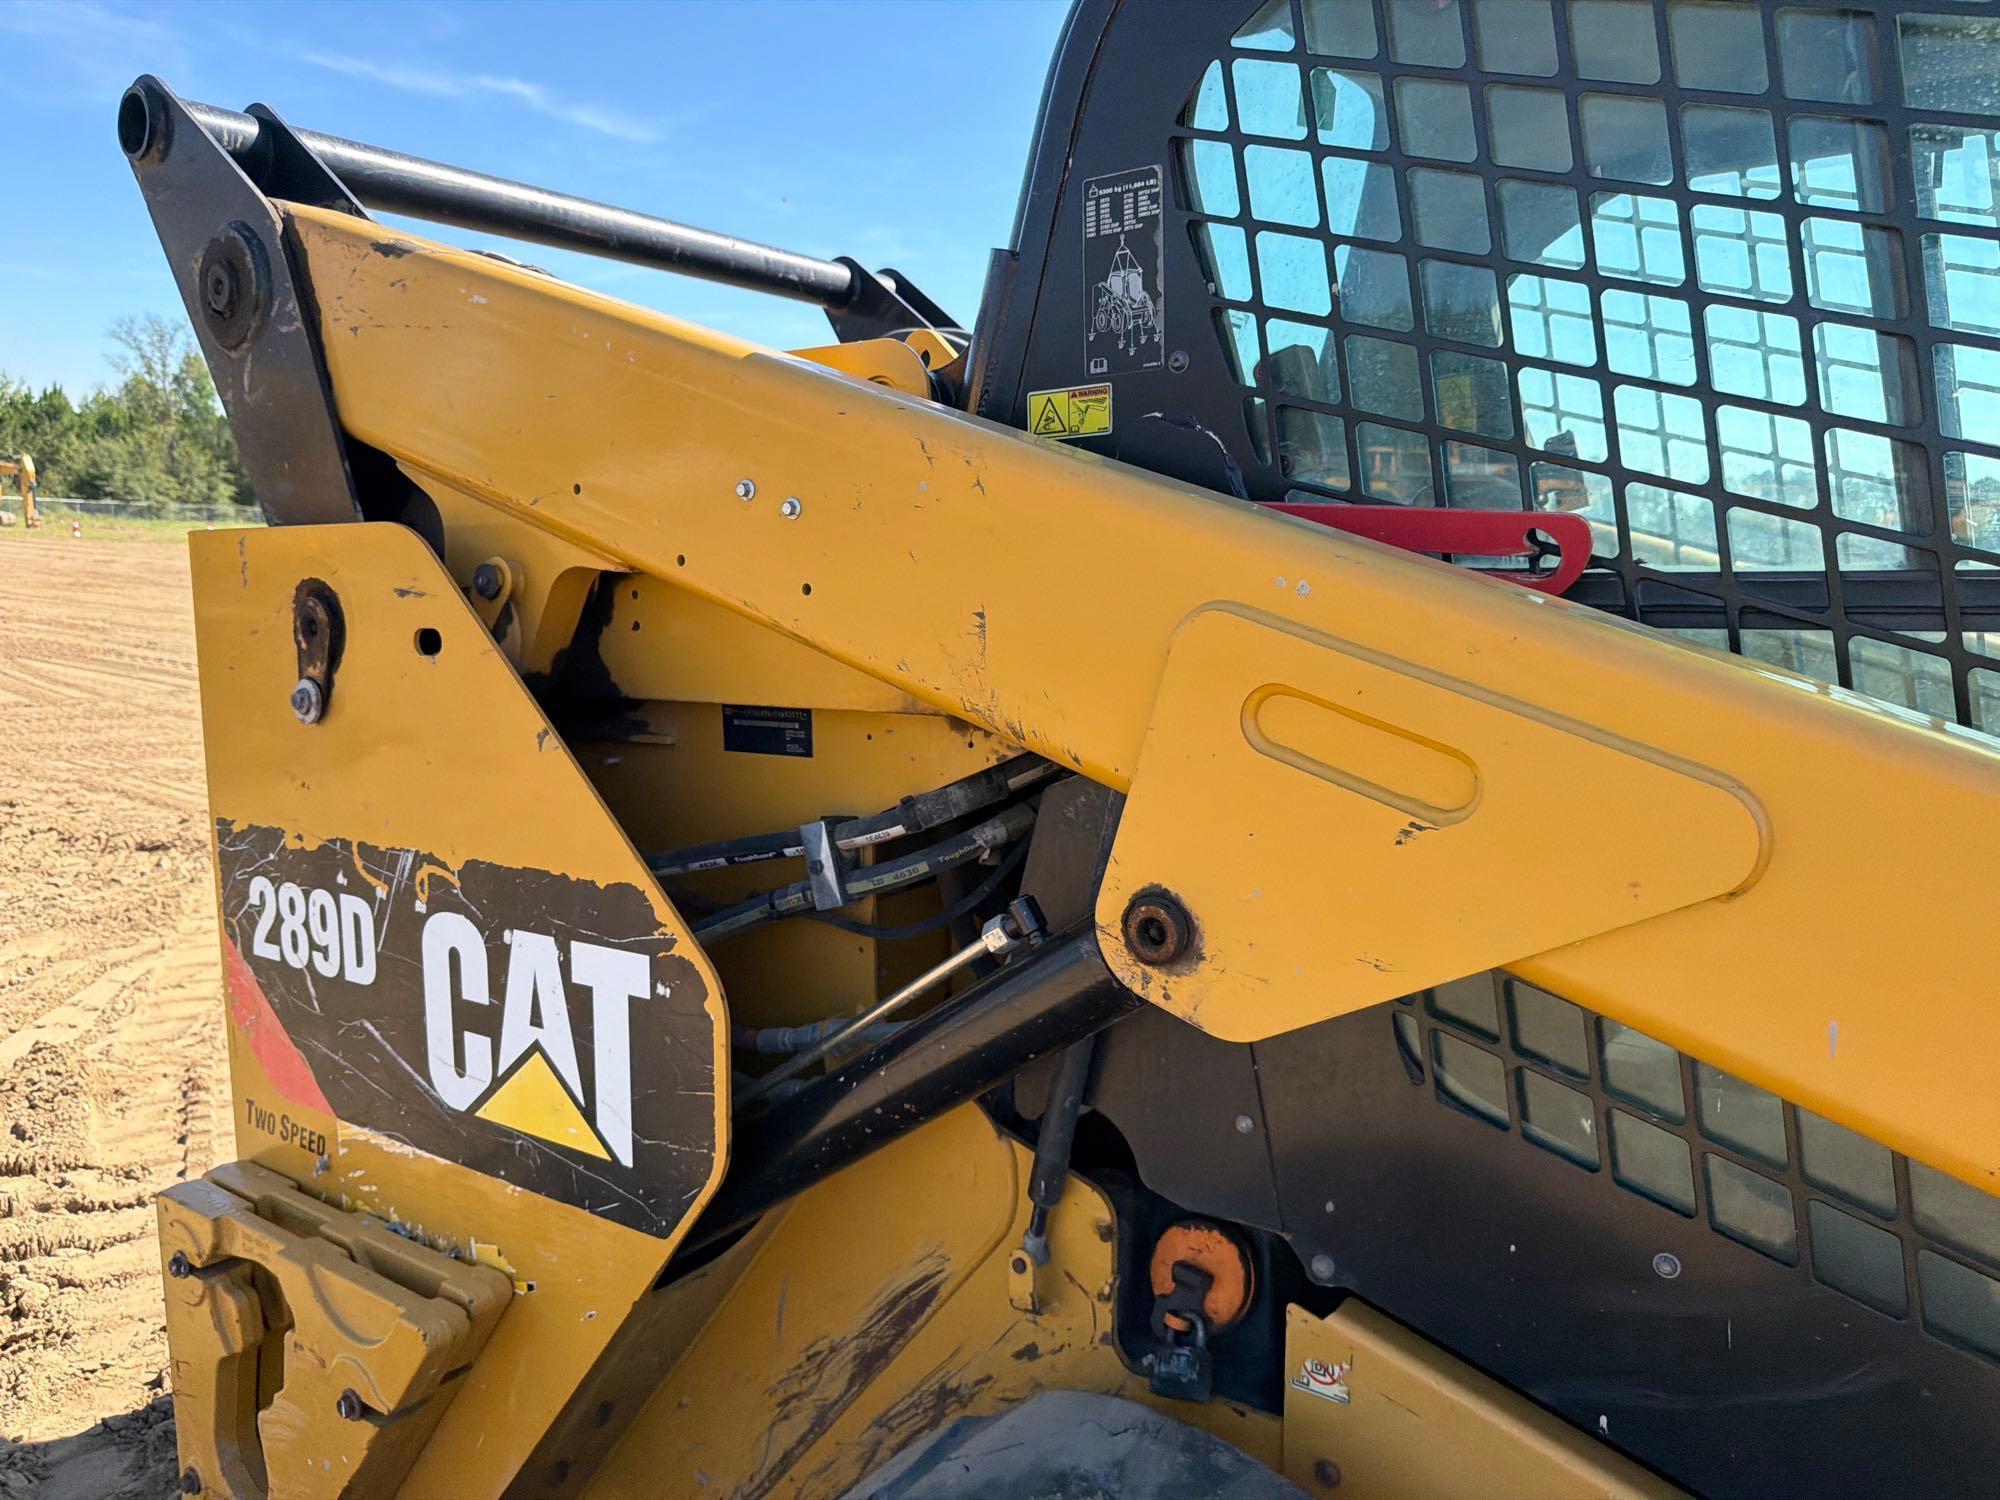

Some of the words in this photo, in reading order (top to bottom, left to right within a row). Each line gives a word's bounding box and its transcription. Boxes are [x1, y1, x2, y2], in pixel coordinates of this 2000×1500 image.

[1077, 388, 1108, 398] WARNING
[249, 876, 377, 986] 289D
[421, 911, 652, 1168] CAT
[246, 1098, 276, 1136] TWO
[280, 1114, 326, 1156] SPEED
